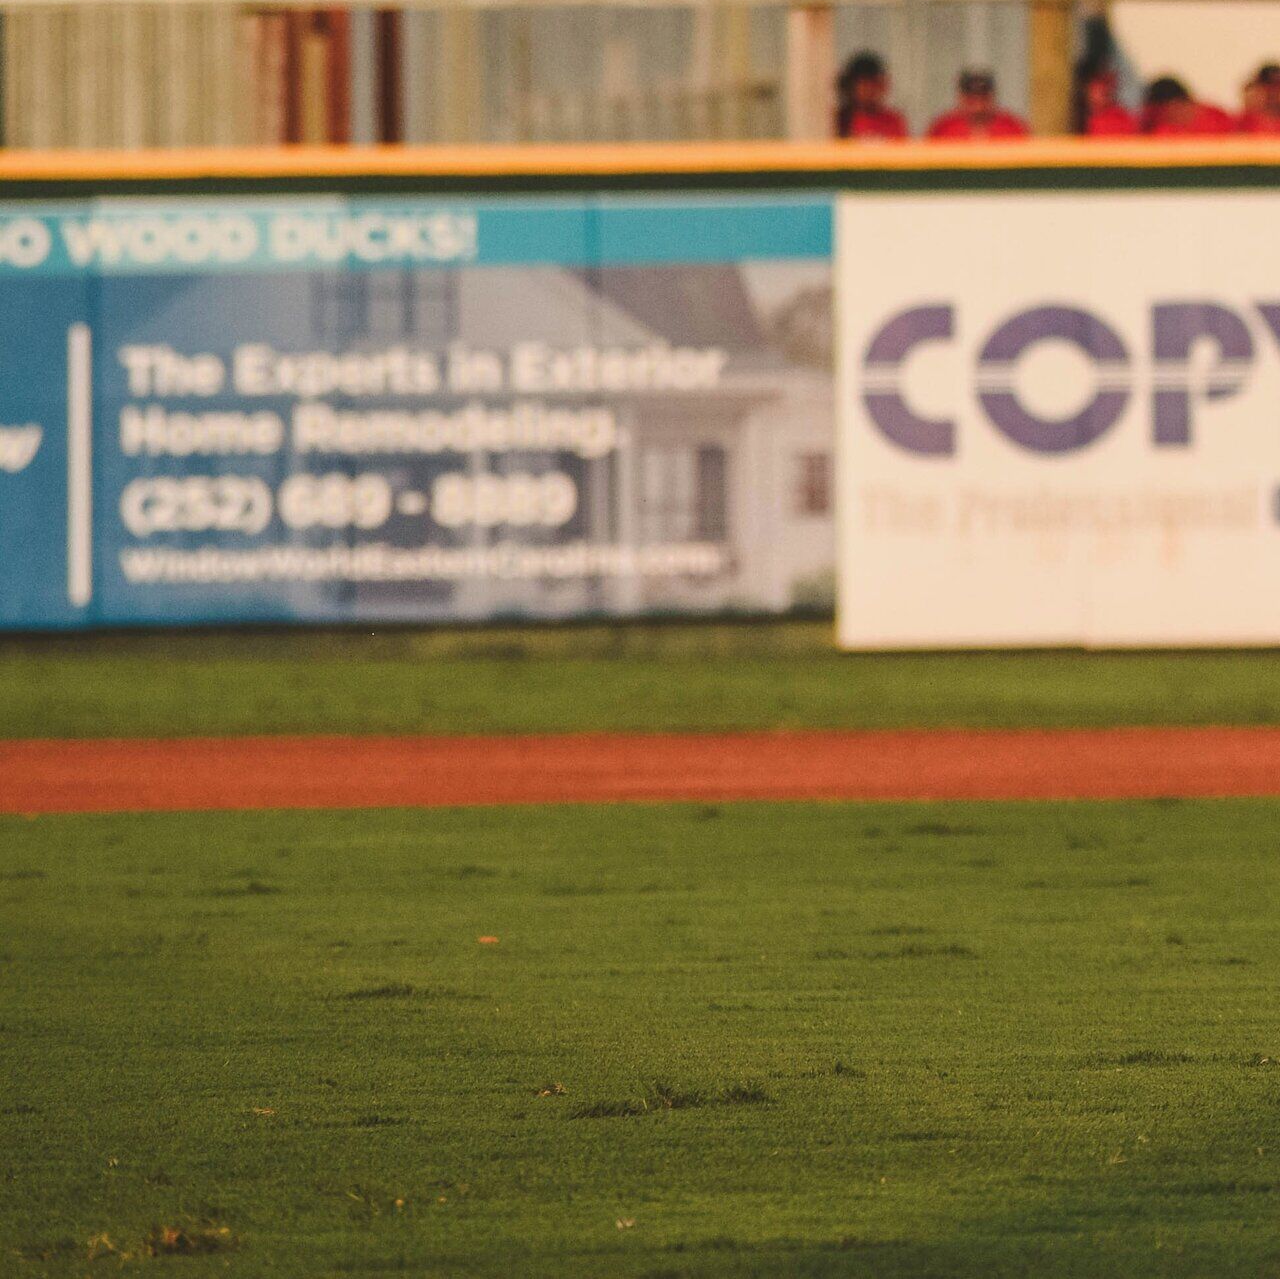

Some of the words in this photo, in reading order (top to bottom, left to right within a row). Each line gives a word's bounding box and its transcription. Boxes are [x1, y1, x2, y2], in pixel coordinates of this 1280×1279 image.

[62, 215, 259, 266] WOOD
[270, 210, 477, 264] DUCKS!
[119, 345, 224, 396] The
[232, 344, 438, 398] Experts
[449, 342, 503, 392] in
[510, 342, 728, 392] Exterior
[119, 405, 282, 456] Home
[121, 475, 272, 534] (252)
